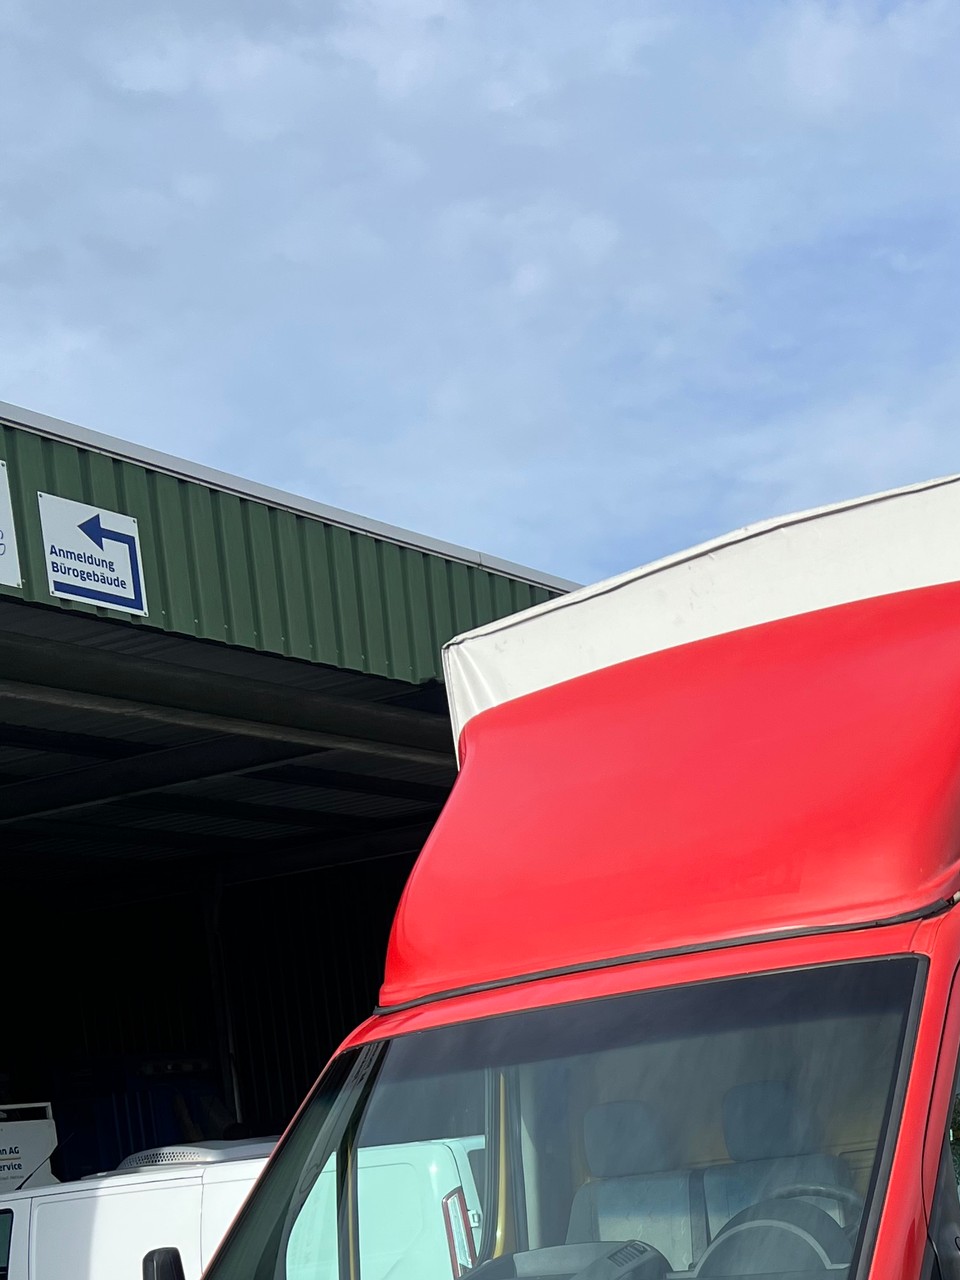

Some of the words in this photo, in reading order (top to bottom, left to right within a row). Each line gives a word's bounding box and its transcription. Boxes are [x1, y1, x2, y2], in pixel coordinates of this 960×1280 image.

[50, 545, 115, 572] Anmeldung
[51, 561, 127, 589] Bürogebäude
[9, 1146, 20, 1155] AG
